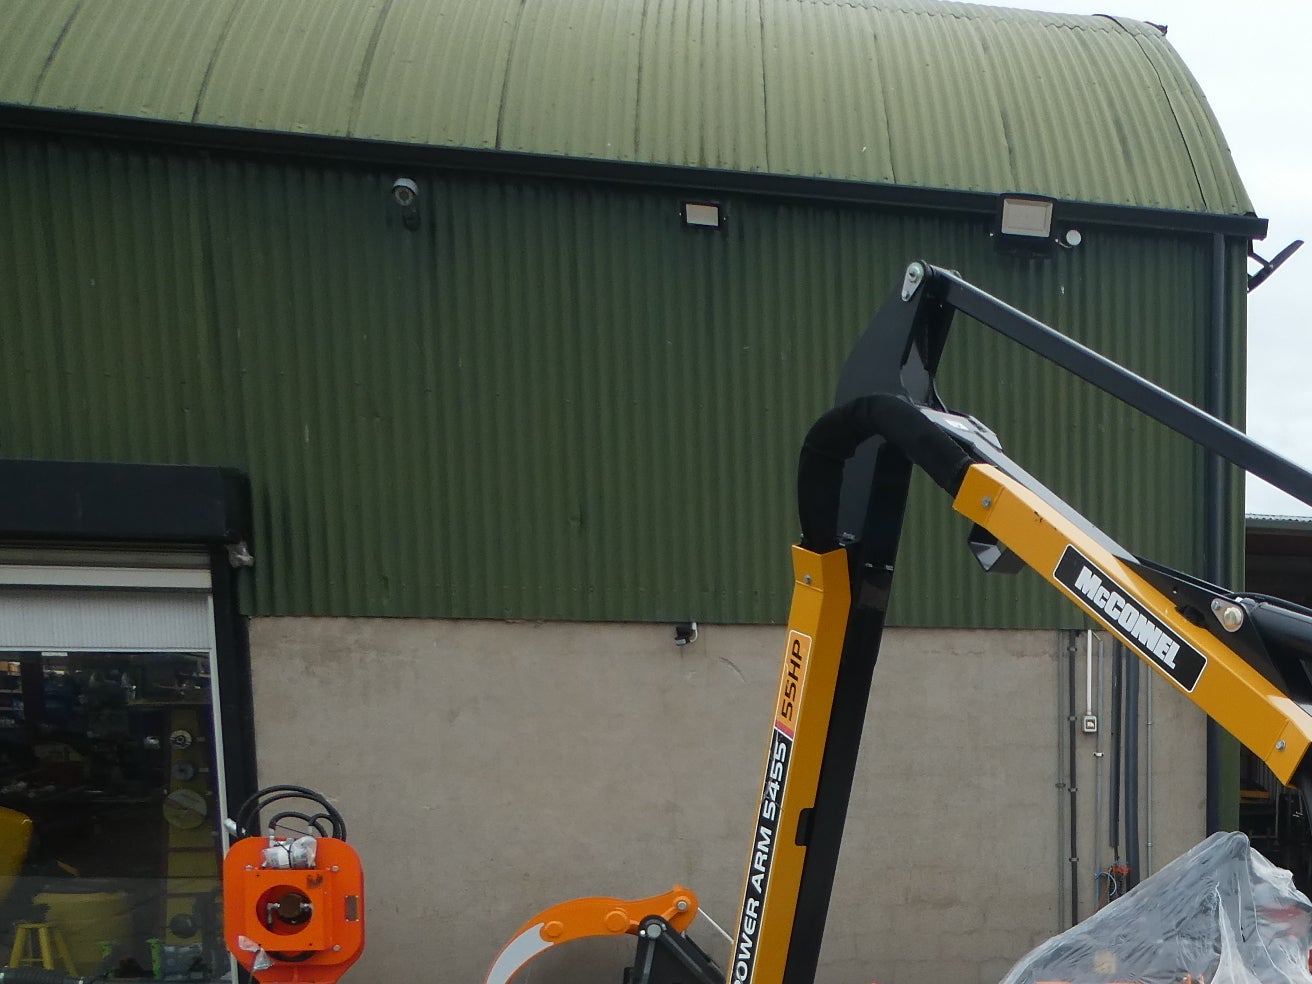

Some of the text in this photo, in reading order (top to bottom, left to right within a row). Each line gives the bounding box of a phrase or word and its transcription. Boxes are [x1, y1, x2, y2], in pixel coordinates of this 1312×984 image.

[1074, 565, 1181, 670] McCONNEL
[781, 638, 803, 722] 55HP
[749, 825, 772, 894] ARM
[762, 740, 788, 821] 5455
